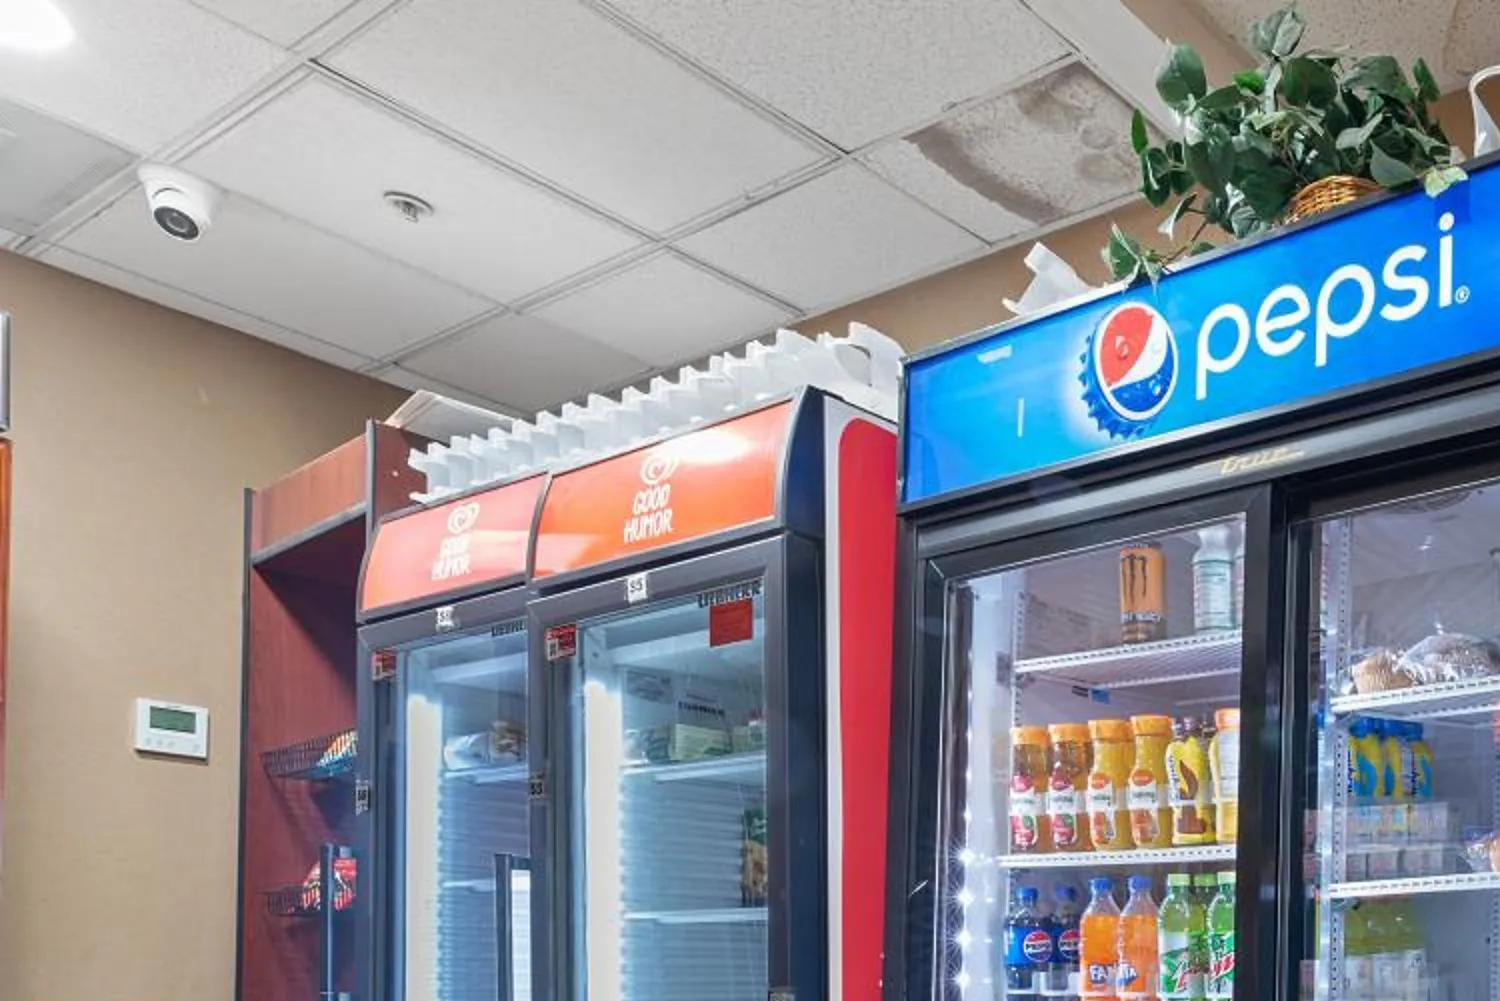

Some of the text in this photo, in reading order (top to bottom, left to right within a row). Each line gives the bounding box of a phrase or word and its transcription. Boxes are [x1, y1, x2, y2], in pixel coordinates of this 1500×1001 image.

[1195, 212, 1454, 401] pepsi
[632, 484, 672, 516] GOOD
[622, 507, 674, 545] HUMOR
